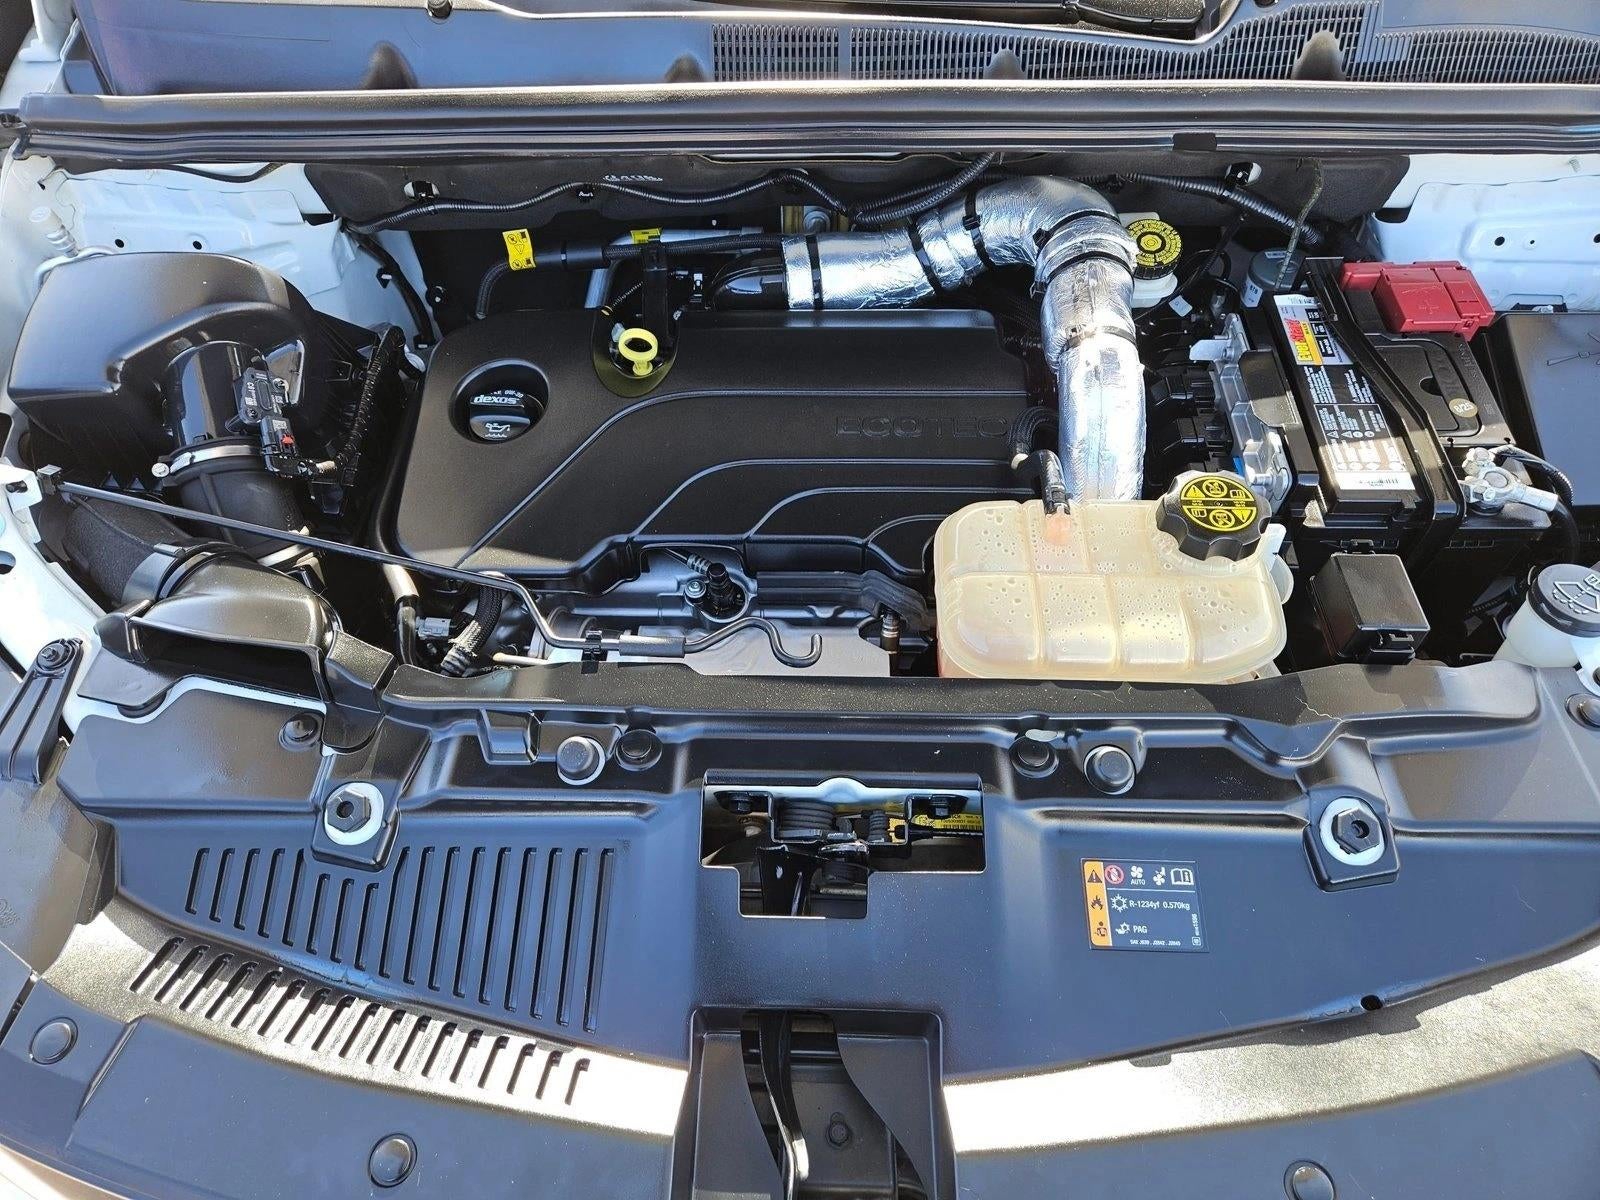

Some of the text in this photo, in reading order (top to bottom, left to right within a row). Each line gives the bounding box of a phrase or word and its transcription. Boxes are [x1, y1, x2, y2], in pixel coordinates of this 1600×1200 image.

[1283, 317, 1314, 361] EverStart
[473, 394, 517, 404] dexos
[834, 416, 1008, 438] ECOTEC
[1130, 878, 1146, 886] AUTO
[1129, 900, 1191, 911] R-1234yf 0.570kg
[1132, 925, 1148, 934] PAG
